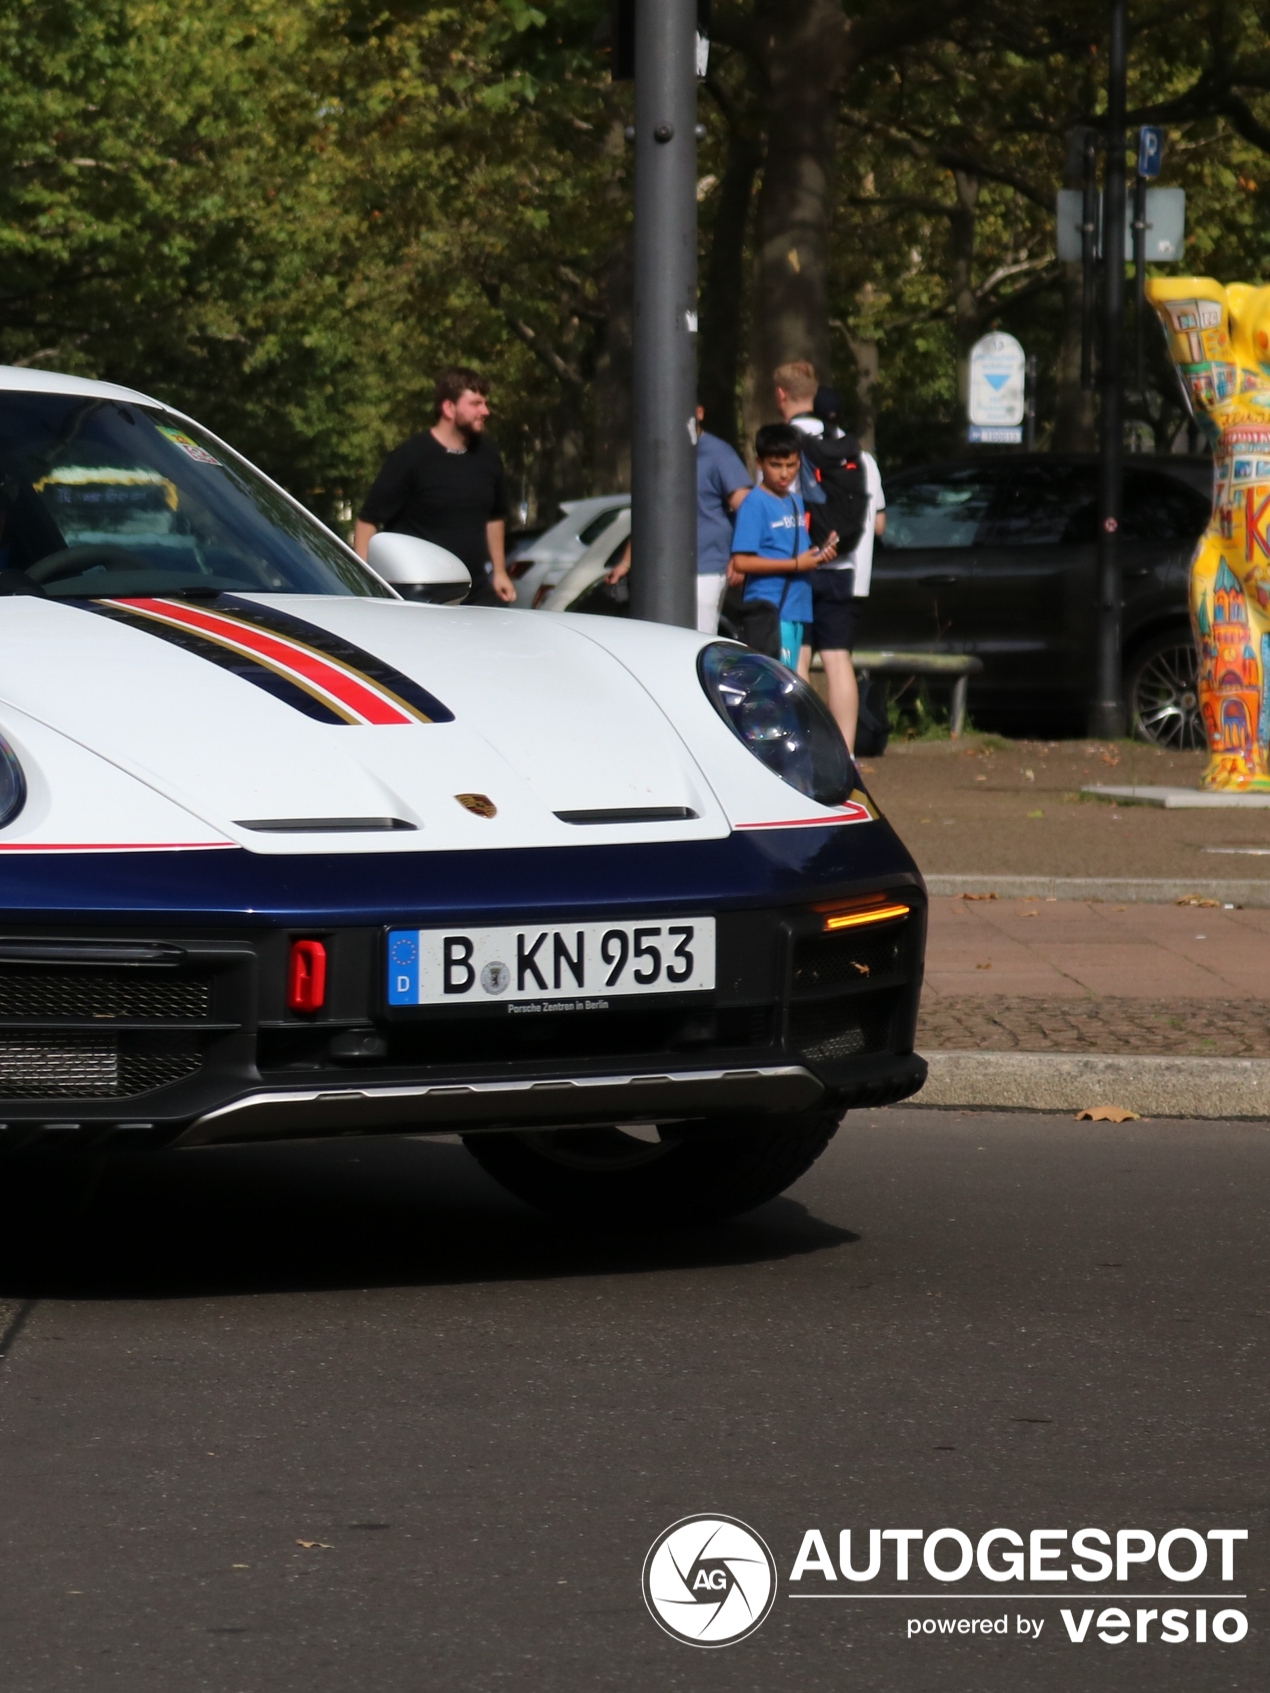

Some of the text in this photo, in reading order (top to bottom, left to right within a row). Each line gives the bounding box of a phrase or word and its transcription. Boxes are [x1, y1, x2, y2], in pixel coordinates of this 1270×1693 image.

[443, 935, 476, 994] B
[516, 930, 585, 991] KN
[600, 925, 694, 986] 953
[397, 975, 410, 993] D
[508, 1000, 609, 1014] Porsche Zentren in Berlin
